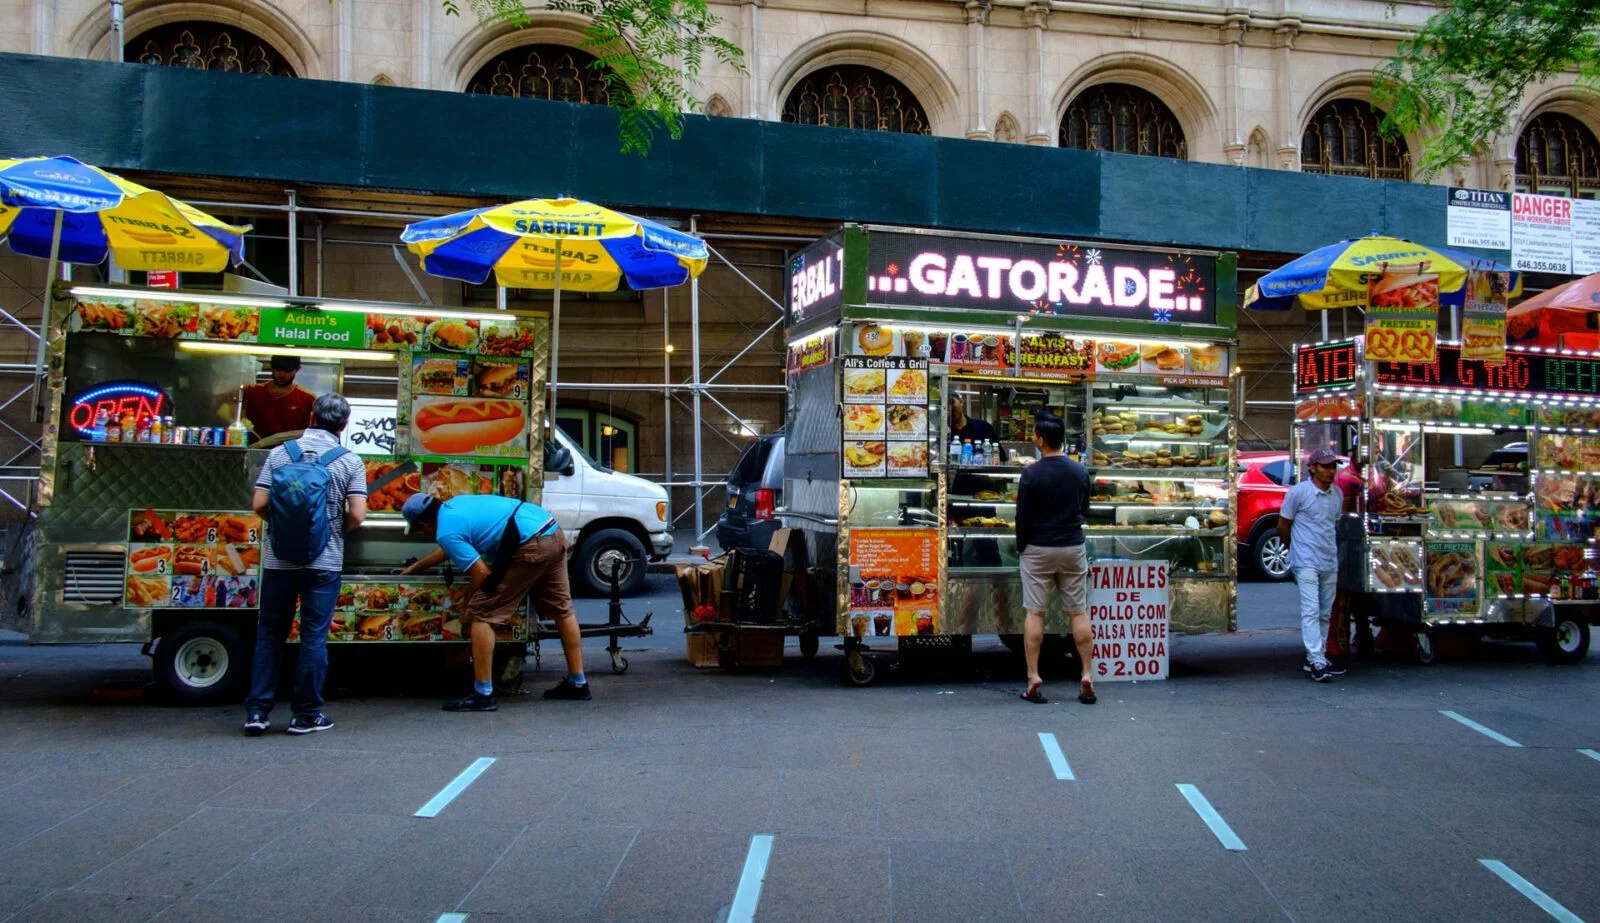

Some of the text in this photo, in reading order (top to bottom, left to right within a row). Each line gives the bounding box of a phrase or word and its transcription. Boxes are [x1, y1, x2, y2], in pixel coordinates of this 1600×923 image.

[1470, 191, 1504, 203] TITAN
[1513, 196, 1571, 218] DANGER
[1513, 214, 1571, 226] MEN WORKING ABOVE
[514, 219, 606, 237] SABRETT
[1351, 251, 1427, 266] SABRETT
[1517, 260, 1567, 272] 646.355.0638
[285, 313, 337, 326] Adam's
[1380, 320, 1422, 329] PRETZEL
[275, 327, 350, 342] Halal Food
[1029, 336, 1067, 348] ALY'S
[844, 358, 928, 369] Ali's Coffee & Grill
[1009, 351, 1087, 366] BREAKFAST
[979, 368, 1002, 376] COFFEE
[1164, 377, 1178, 385] PICK
[514, 385, 521, 398] 9
[70, 393, 164, 430] OPEN
[208, 528, 215, 542] 6
[250, 529, 256, 542] 3
[1428, 543, 1442, 551] HOT
[158, 560, 166, 573] 3
[202, 561, 209, 574] 4
[1091, 566, 1166, 589] TAMALES
[173, 588, 180, 600] 2
[1116, 592, 1141, 602] DE
[1090, 604, 1166, 621] POLLO COM
[386, 627, 392, 639] 8
[514, 627, 520, 640] 6
[1091, 623, 1166, 640] SALSA VERDE
[1091, 642, 1166, 659] AND ROJA
[1098, 660, 1160, 676] $ 2.00
